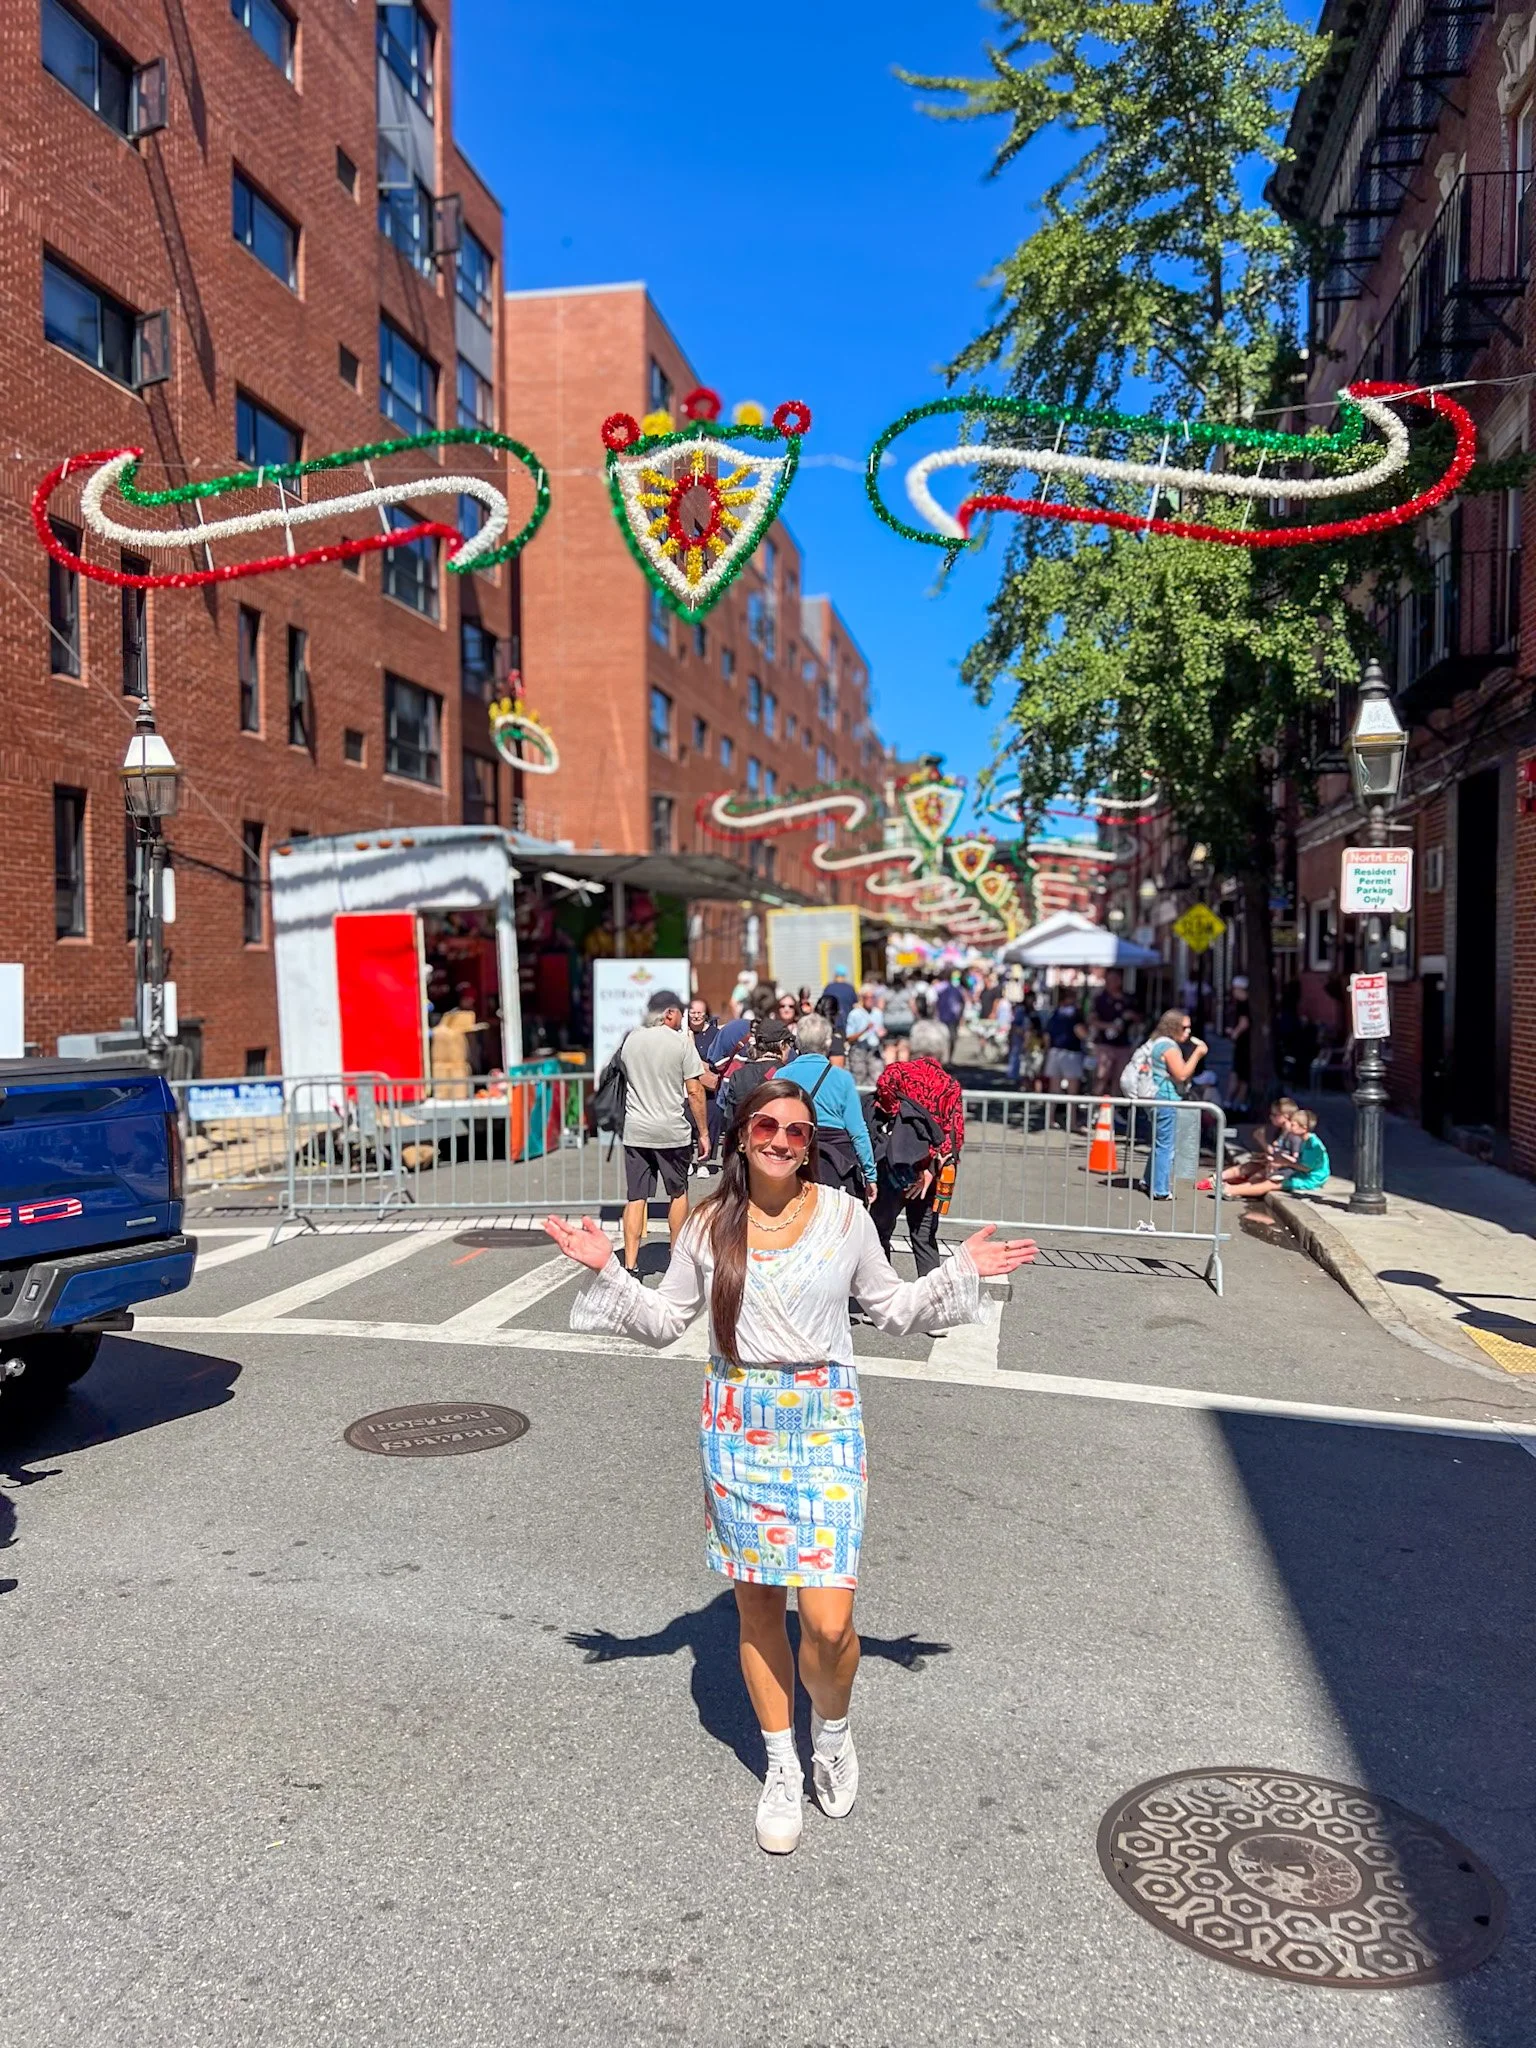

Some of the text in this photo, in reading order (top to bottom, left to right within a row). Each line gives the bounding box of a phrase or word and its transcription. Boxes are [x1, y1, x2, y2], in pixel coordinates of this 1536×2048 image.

[1387, 852, 1409, 862] End
[1354, 868, 1396, 876] Resident
[1359, 877, 1391, 885] Permit
[1356, 886, 1393, 896] Parking
[1363, 895, 1385, 905] Only
